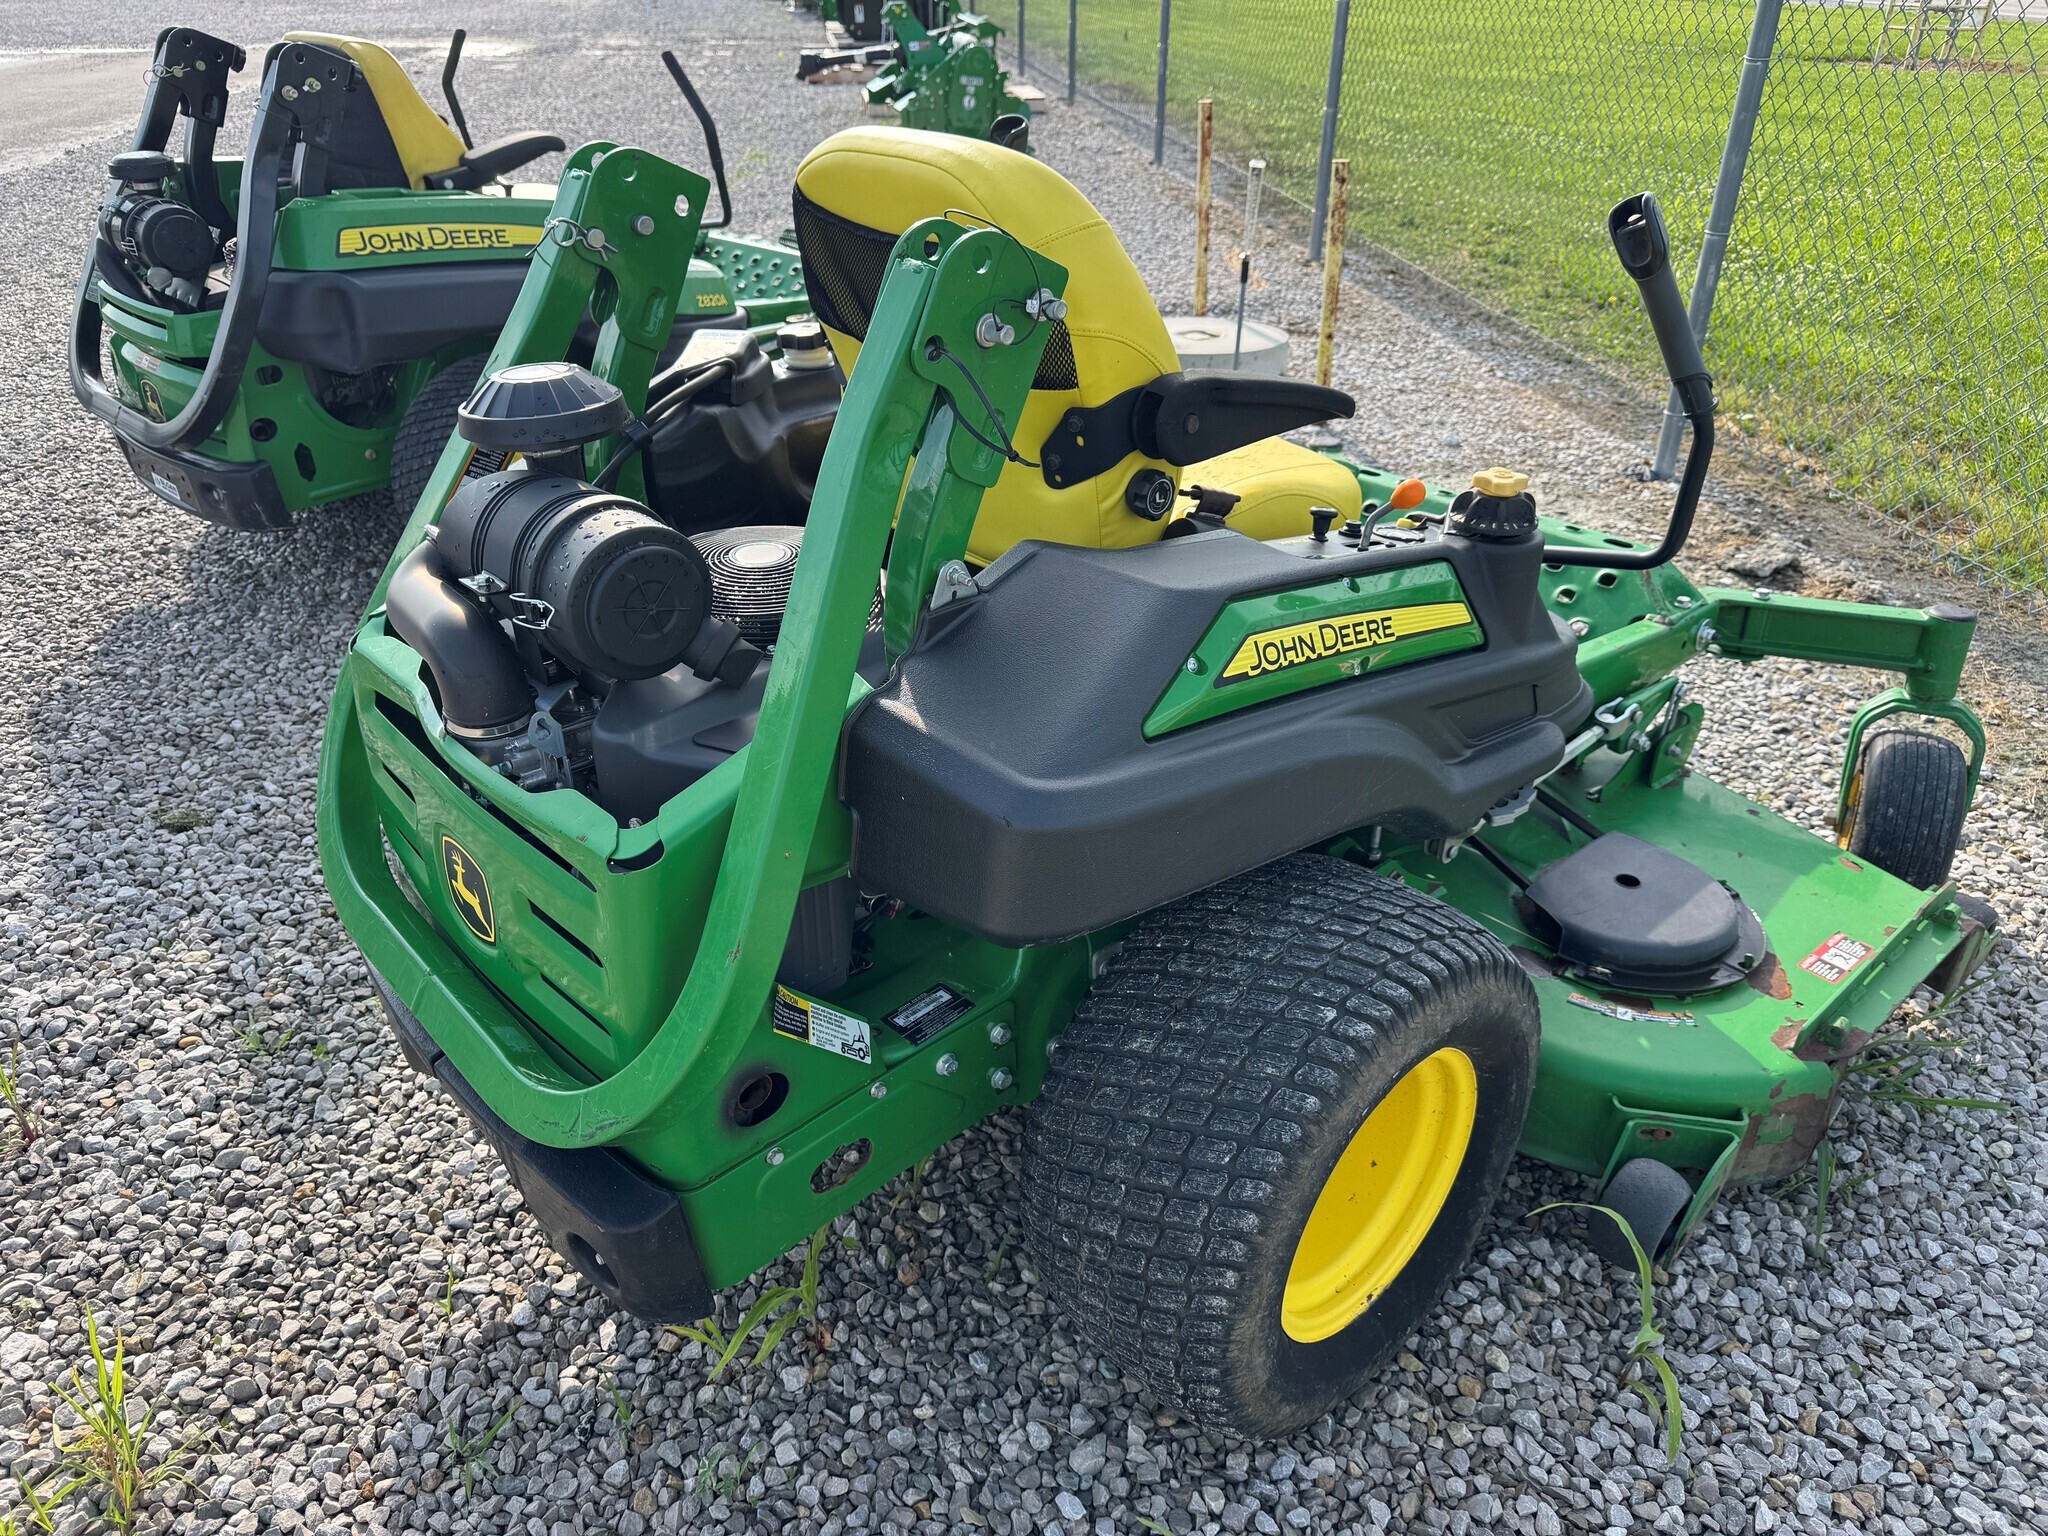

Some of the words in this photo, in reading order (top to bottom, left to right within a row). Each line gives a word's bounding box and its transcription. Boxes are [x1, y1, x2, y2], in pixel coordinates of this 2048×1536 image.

[355, 231, 424, 251] JOHN
[427, 227, 510, 247] DEERE
[1250, 632, 1317, 671] JOHN
[1318, 616, 1395, 650] DEERE
